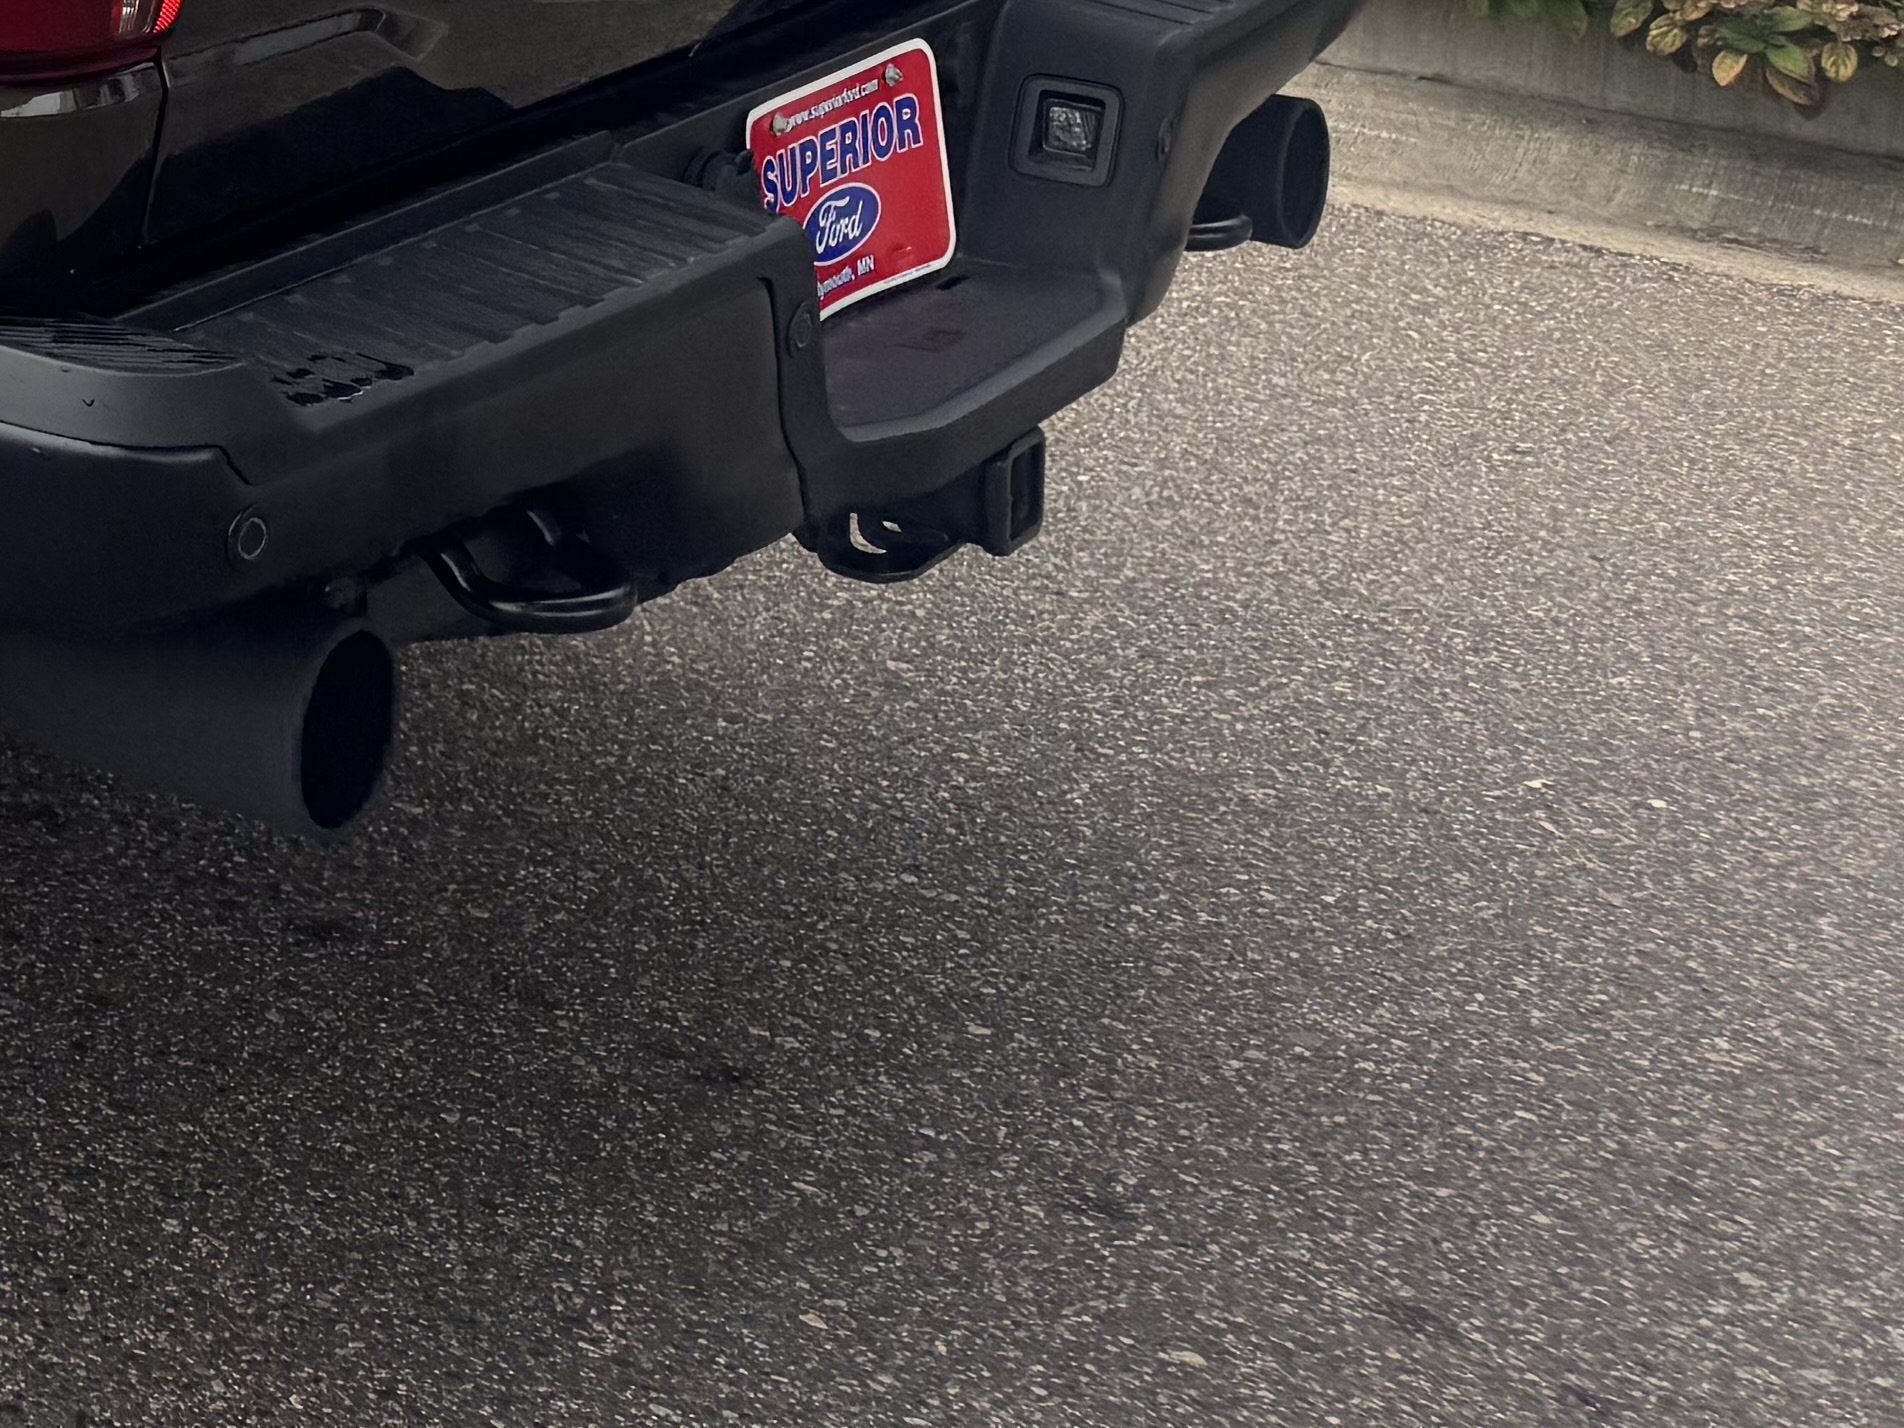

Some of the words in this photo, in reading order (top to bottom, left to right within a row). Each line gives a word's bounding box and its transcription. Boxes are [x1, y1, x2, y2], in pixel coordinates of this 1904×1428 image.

[761, 92, 924, 213] SUPERIOR
[815, 196, 864, 255] Ford
[857, 254, 875, 277] MN
